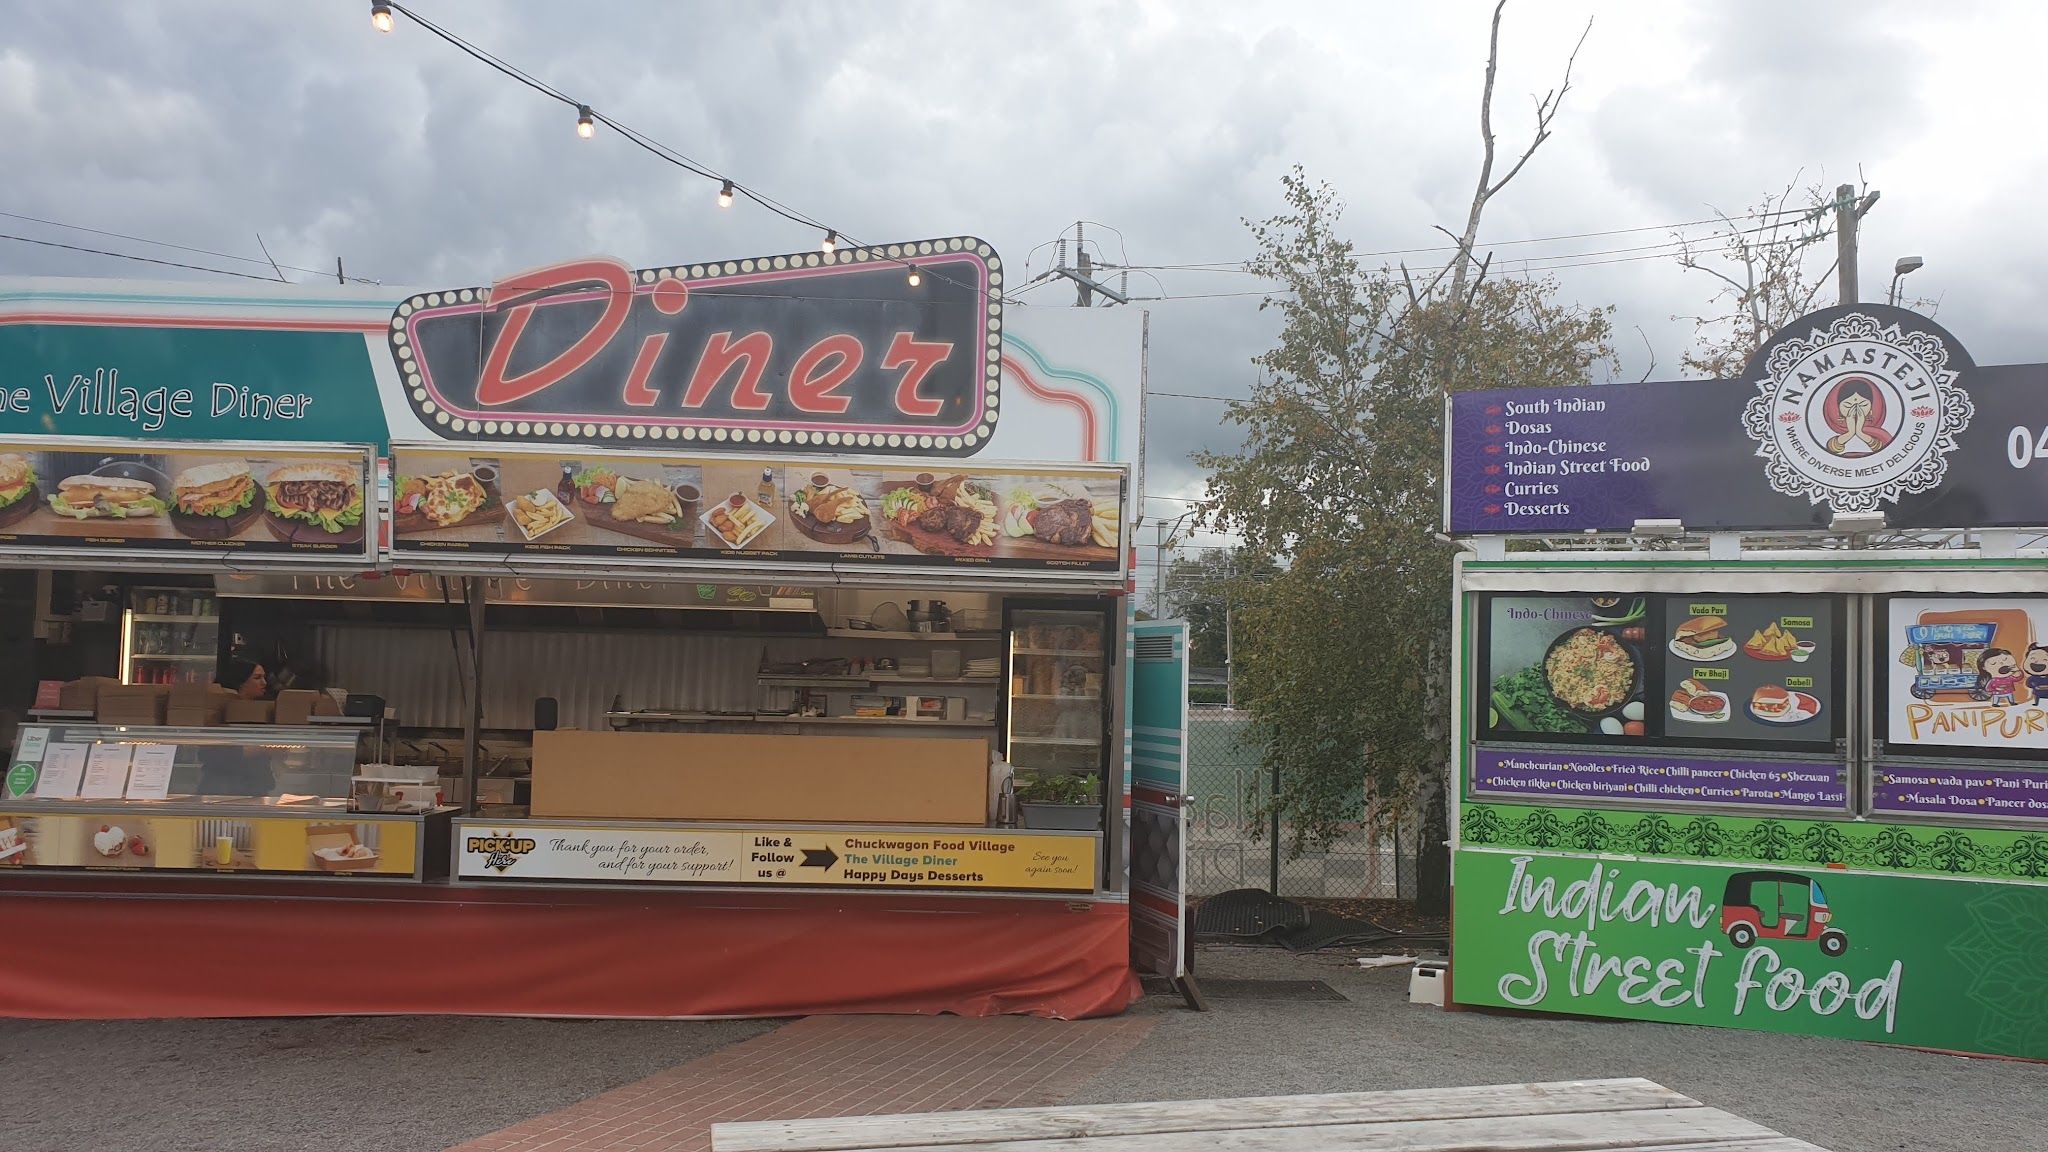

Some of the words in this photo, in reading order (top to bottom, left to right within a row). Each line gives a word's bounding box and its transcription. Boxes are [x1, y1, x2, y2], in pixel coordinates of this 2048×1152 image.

[475, 257, 954, 417] Diner
[1782, 348, 1930, 405] NAMASTEJI
[44, 367, 193, 431] Village
[211, 382, 312, 420] Diner
[1505, 400, 1550, 416] South
[1553, 398, 1606, 413] Indian
[1505, 421, 1552, 435] Dosas
[1505, 439, 1607, 456] Indo-Chinese
[1786, 425, 1810, 460] WHERE
[1807, 456, 1852, 478] DIVERSE
[1855, 463, 1884, 478] MEET
[1886, 421, 1926, 468] DELICIOUS
[1505, 461, 1556, 476] Indian
[1560, 459, 1606, 475] Street
[1609, 457, 1650, 473] Food
[1504, 482, 1559, 497] Curries
[1504, 501, 1570, 516] Desserts
[1711, 606, 1724, 614] Pav
[1783, 618, 1811, 627] Samosa
[1695, 669, 1707, 678] Pav
[1709, 670, 1727, 679] Bhaji
[1569, 763, 1605, 773] Noodles
[1611, 764, 1636, 774] Fried
[1638, 766, 1659, 776] Rice
[1666, 767, 1689, 776] Chilli
[1691, 769, 1723, 779] paneer
[1730, 769, 1766, 780] Chicken
[1769, 772, 1780, 782] 65
[1787, 771, 1829, 783] Shezwan
[1888, 774, 1929, 785] Samosa
[1937, 776, 1962, 786] vada
[1965, 779, 1985, 789] pav
[1993, 778, 2019, 789] Pani
[1492, 777, 1526, 787] Chicken
[1528, 779, 1550, 788] tikka
[1557, 780, 1591, 791] Chicken
[1593, 781, 1627, 792] biriyani
[1634, 784, 1657, 793] Chilli
[1659, 784, 1694, 796] chicken
[1701, 786, 1734, 797] Curries
[1741, 788, 1774, 798] Parota
[1780, 787, 1815, 802] Mango
[1817, 791, 1843, 802] Lassi
[1906, 792, 1946, 804] Masala
[1949, 796, 1977, 806] Dosa
[1985, 797, 2026, 808] Paneer
[550, 838, 590, 854] Thank
[591, 844, 615, 858] you
[617, 840, 637, 858] for
[640, 845, 671, 859] your
[674, 841, 710, 856] order,
[754, 837, 780, 847] Like
[784, 838, 792, 847] &
[845, 838, 928, 851] Chuckwagon
[933, 840, 964, 850] Food
[968, 841, 1015, 853] Village
[485, 851, 517, 869] Here
[751, 852, 794, 863] Follow
[844, 854, 868, 864] The
[872, 854, 918, 867] Village
[923, 855, 957, 866] Diner
[1032, 852, 1049, 861] See
[1051, 855, 1070, 865] you
[598, 857, 627, 869] and
[624, 857, 645, 875] for
[648, 862, 678, 876] your
[681, 859, 734, 877] support!
[758, 870, 772, 878] us
[775, 868, 787, 878] @
[1025, 866, 1052, 877] again
[1054, 865, 1078, 874] soon!
[844, 869, 887, 881] Happy
[891, 870, 923, 882] Days
[928, 871, 983, 882] Desserts
[1499, 855, 1716, 930] Indian
[1733, 946, 1902, 1034] food
